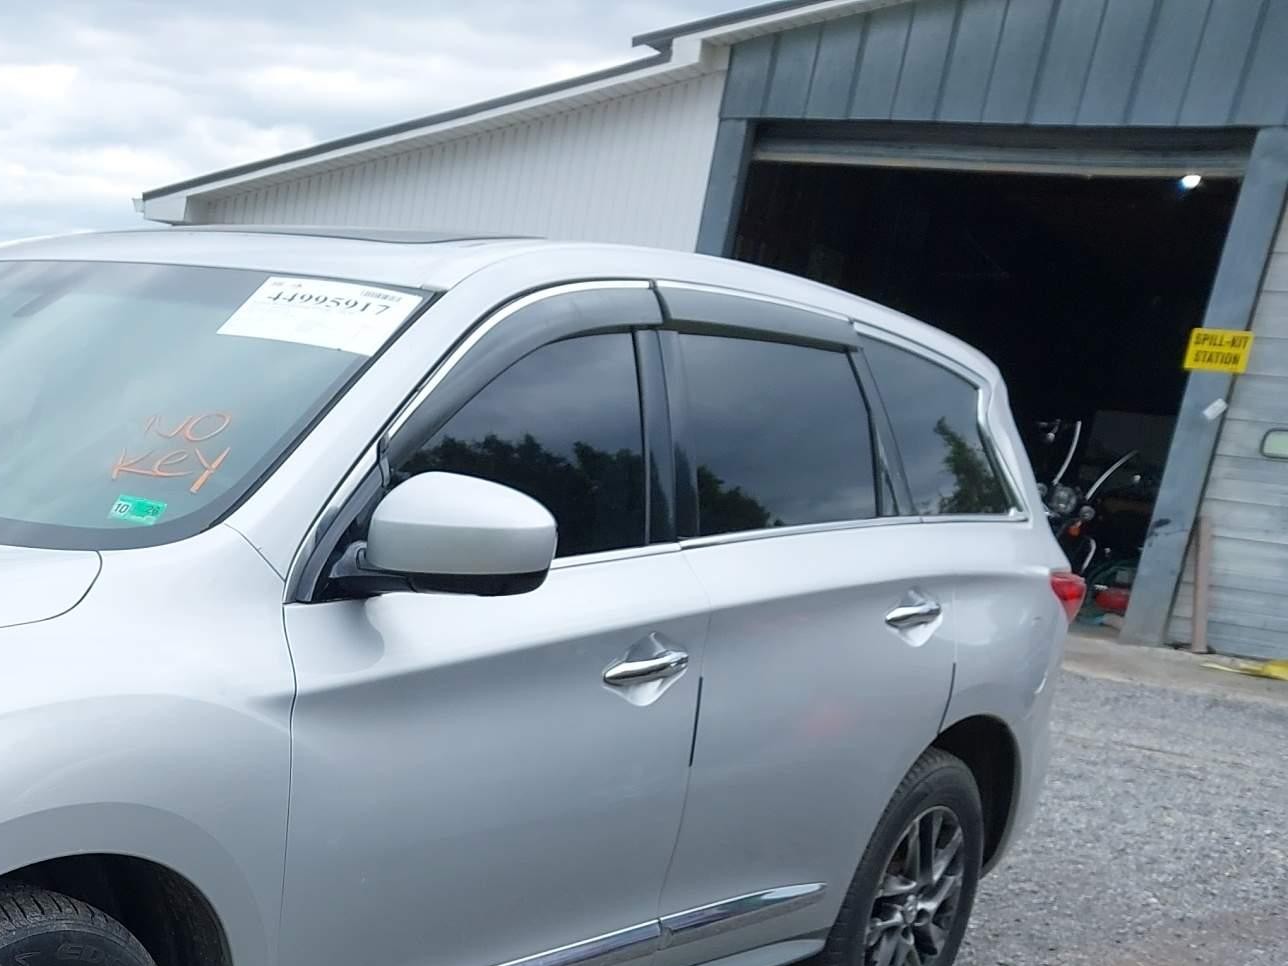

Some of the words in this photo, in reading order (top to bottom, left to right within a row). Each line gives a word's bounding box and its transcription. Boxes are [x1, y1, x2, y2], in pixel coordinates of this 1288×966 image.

[266, 290, 392, 316] 44995917
[1193, 332, 1250, 350] SPILL-KIT
[1193, 350, 1241, 366] STATION
[114, 502, 130, 514] 10
